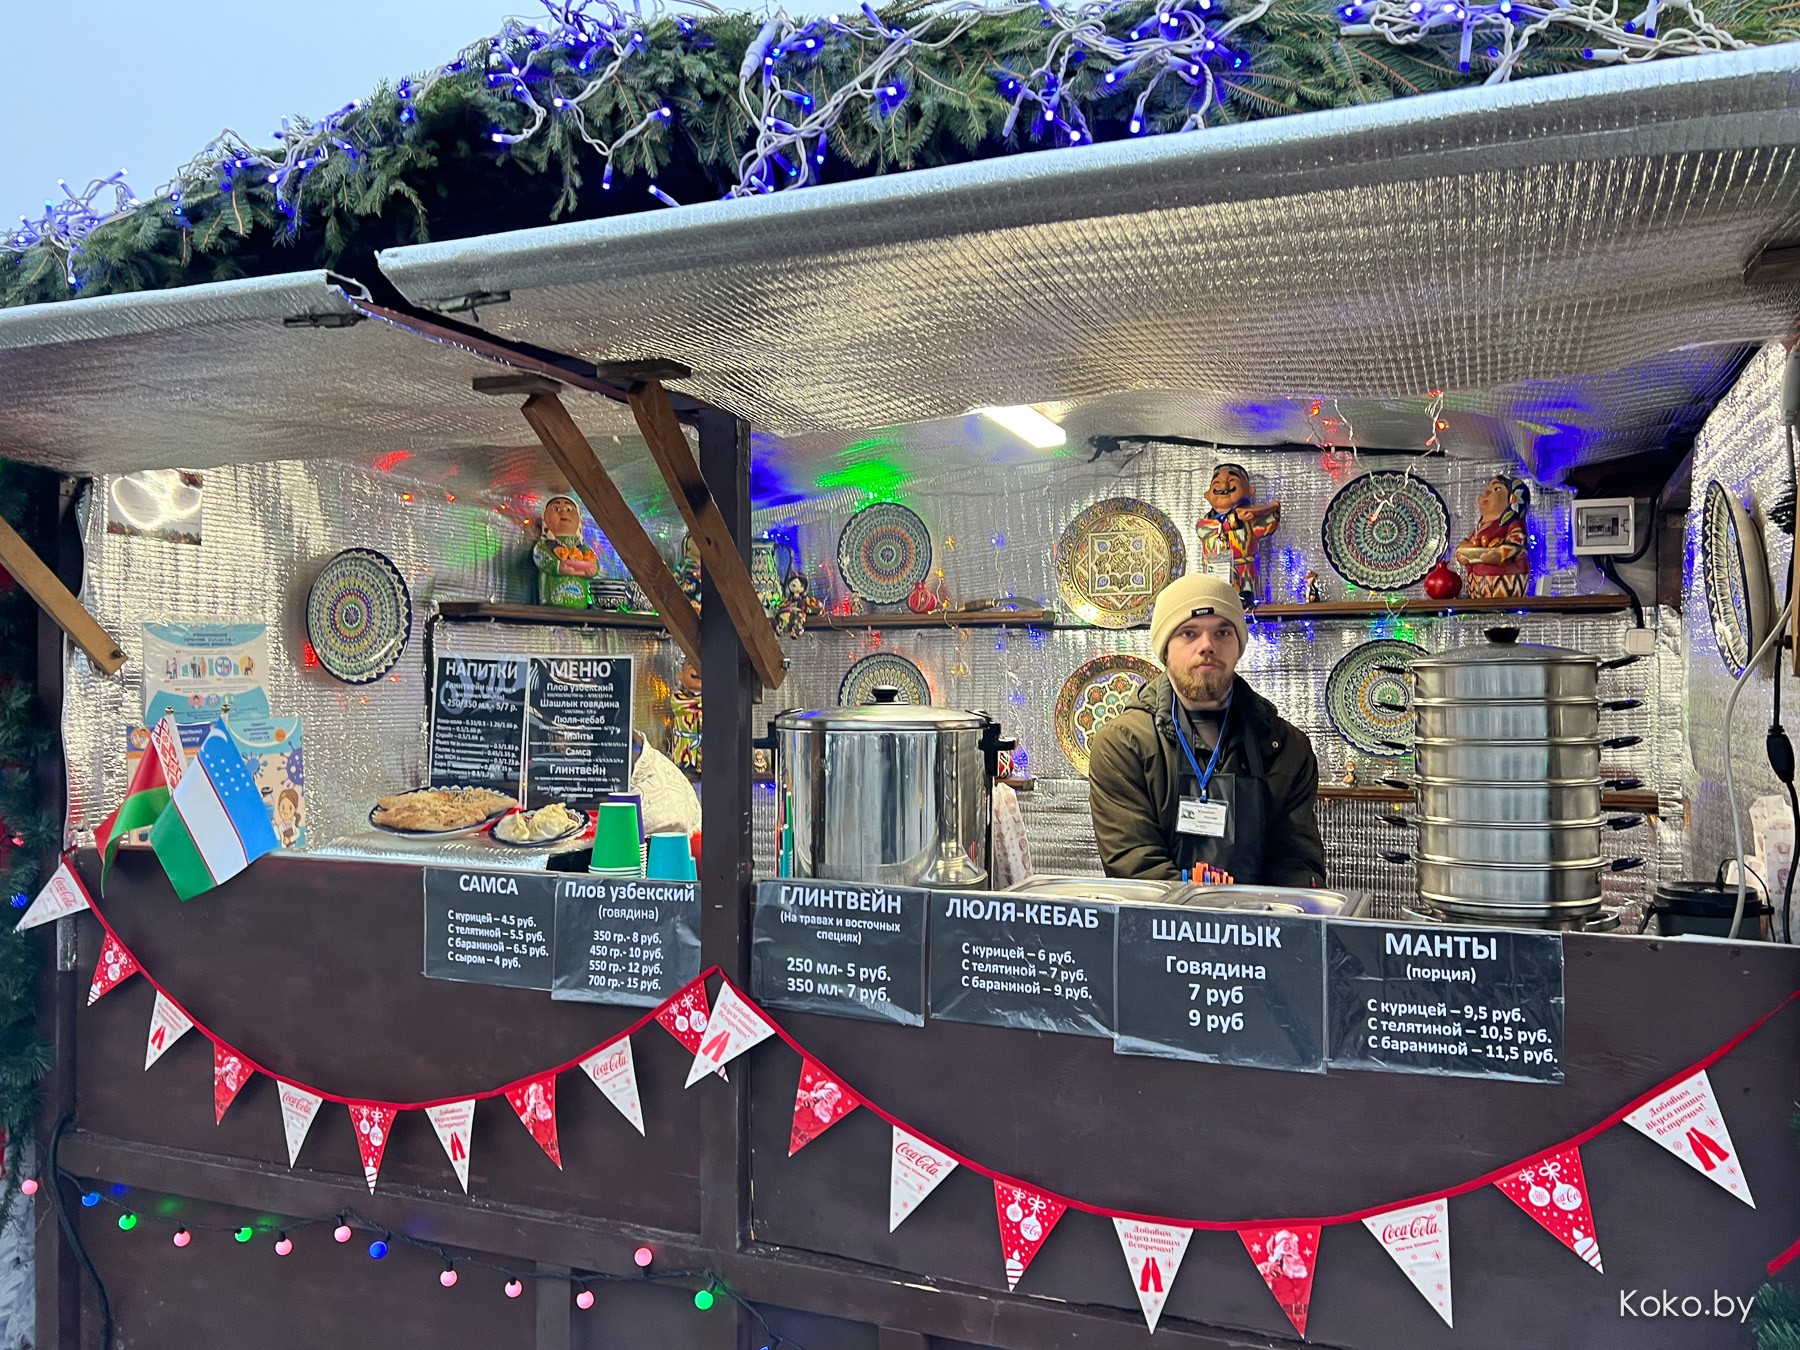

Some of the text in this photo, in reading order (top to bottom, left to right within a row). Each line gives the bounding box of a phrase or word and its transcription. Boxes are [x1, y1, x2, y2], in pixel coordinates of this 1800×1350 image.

[445, 661, 518, 679] НАПИТКИ
[550, 661, 611, 678] МЕНЮ
[547, 683, 614, 693] Плов узбекский
[496, 701, 509, 711] 5/7
[510, 704, 518, 712] р.
[540, 699, 620, 709] Шашлык говядина
[553, 715, 605, 725] Люля-кебаб
[565, 747, 592, 756] Самса
[549, 764, 606, 776] Глинтвейн
[459, 874, 519, 896] САМСА
[565, 881, 695, 902] Плов узбекский
[780, 886, 902, 915] ГЛИНТВЕЙН
[448, 910, 455, 920] С
[456, 911, 493, 926] курицей
[501, 914, 515, 925] 4.5
[517, 916, 537, 929] руб.
[598, 906, 659, 923] (говядина)
[780, 911, 901, 933] (На травах и восточных
[945, 898, 1099, 929] ЛЮЛЯ-КЕБАБ
[448, 924, 455, 934] С
[456, 925, 502, 939] телятиной
[510, 929, 524, 940] 5.5
[525, 930, 546, 944] руб.
[593, 931, 662, 946] 350 гр.- 8 руб.
[816, 930, 862, 945] специях)
[1152, 918, 1282, 949] ШАШЛЫК
[448, 937, 455, 948] С
[456, 938, 505, 953] бараниной
[513, 943, 528, 954] 6.5
[529, 945, 549, 958] руб.
[589, 945, 664, 961] 450 гр.- 10 руб.
[962, 942, 970, 955] С
[972, 945, 1025, 961] курицей
[1038, 949, 1046, 961] 6
[1049, 951, 1076, 966] руб.
[1385, 932, 1497, 961] МАНТЫ
[448, 951, 455, 962] С
[456, 954, 486, 966] сыром
[494, 957, 500, 967] 4
[501, 957, 522, 969] руб.
[589, 960, 663, 976] 550 гр.- 12 руб.
[787, 957, 892, 983] 250 мл- 5 руб.
[1166, 955, 1266, 981] Говядина
[961, 959, 970, 971] С
[972, 962, 1037, 978] телятиной
[1050, 967, 1058, 979] 7
[1061, 969, 1088, 984] руб.
[1406, 966, 1477, 984] (порция)
[588, 975, 662, 991] 700 гр.- 15 руб.
[787, 977, 891, 1003] 350 мл- 7 руб.
[961, 975, 970, 988] С
[972, 976, 1041, 995] бараниной
[1054, 984, 1062, 996] 9
[1065, 986, 1093, 1001] руб.
[1188, 983, 1244, 1007] 7 руб
[1188, 1009, 1244, 1034] 9 руб
[1367, 998, 1378, 1012] С
[1381, 1001, 1447, 1018] курицей
[1464, 1005, 1488, 1022] 9,5
[1492, 1007, 1526, 1024] руб.
[1367, 1017, 1378, 1031] С
[1381, 1020, 1462, 1038] телятиной
[1480, 1025, 1514, 1042] 10,5
[1517, 1028, 1552, 1045] руб.
[1368, 1035, 1378, 1049] С
[1381, 1035, 1468, 1056] бараниной
[1486, 1045, 1519, 1062] 11,5
[1523, 1047, 1558, 1065] руб.
[1649, 1089, 1691, 1118] Добавим
[1673, 1092, 1707, 1115] нашим
